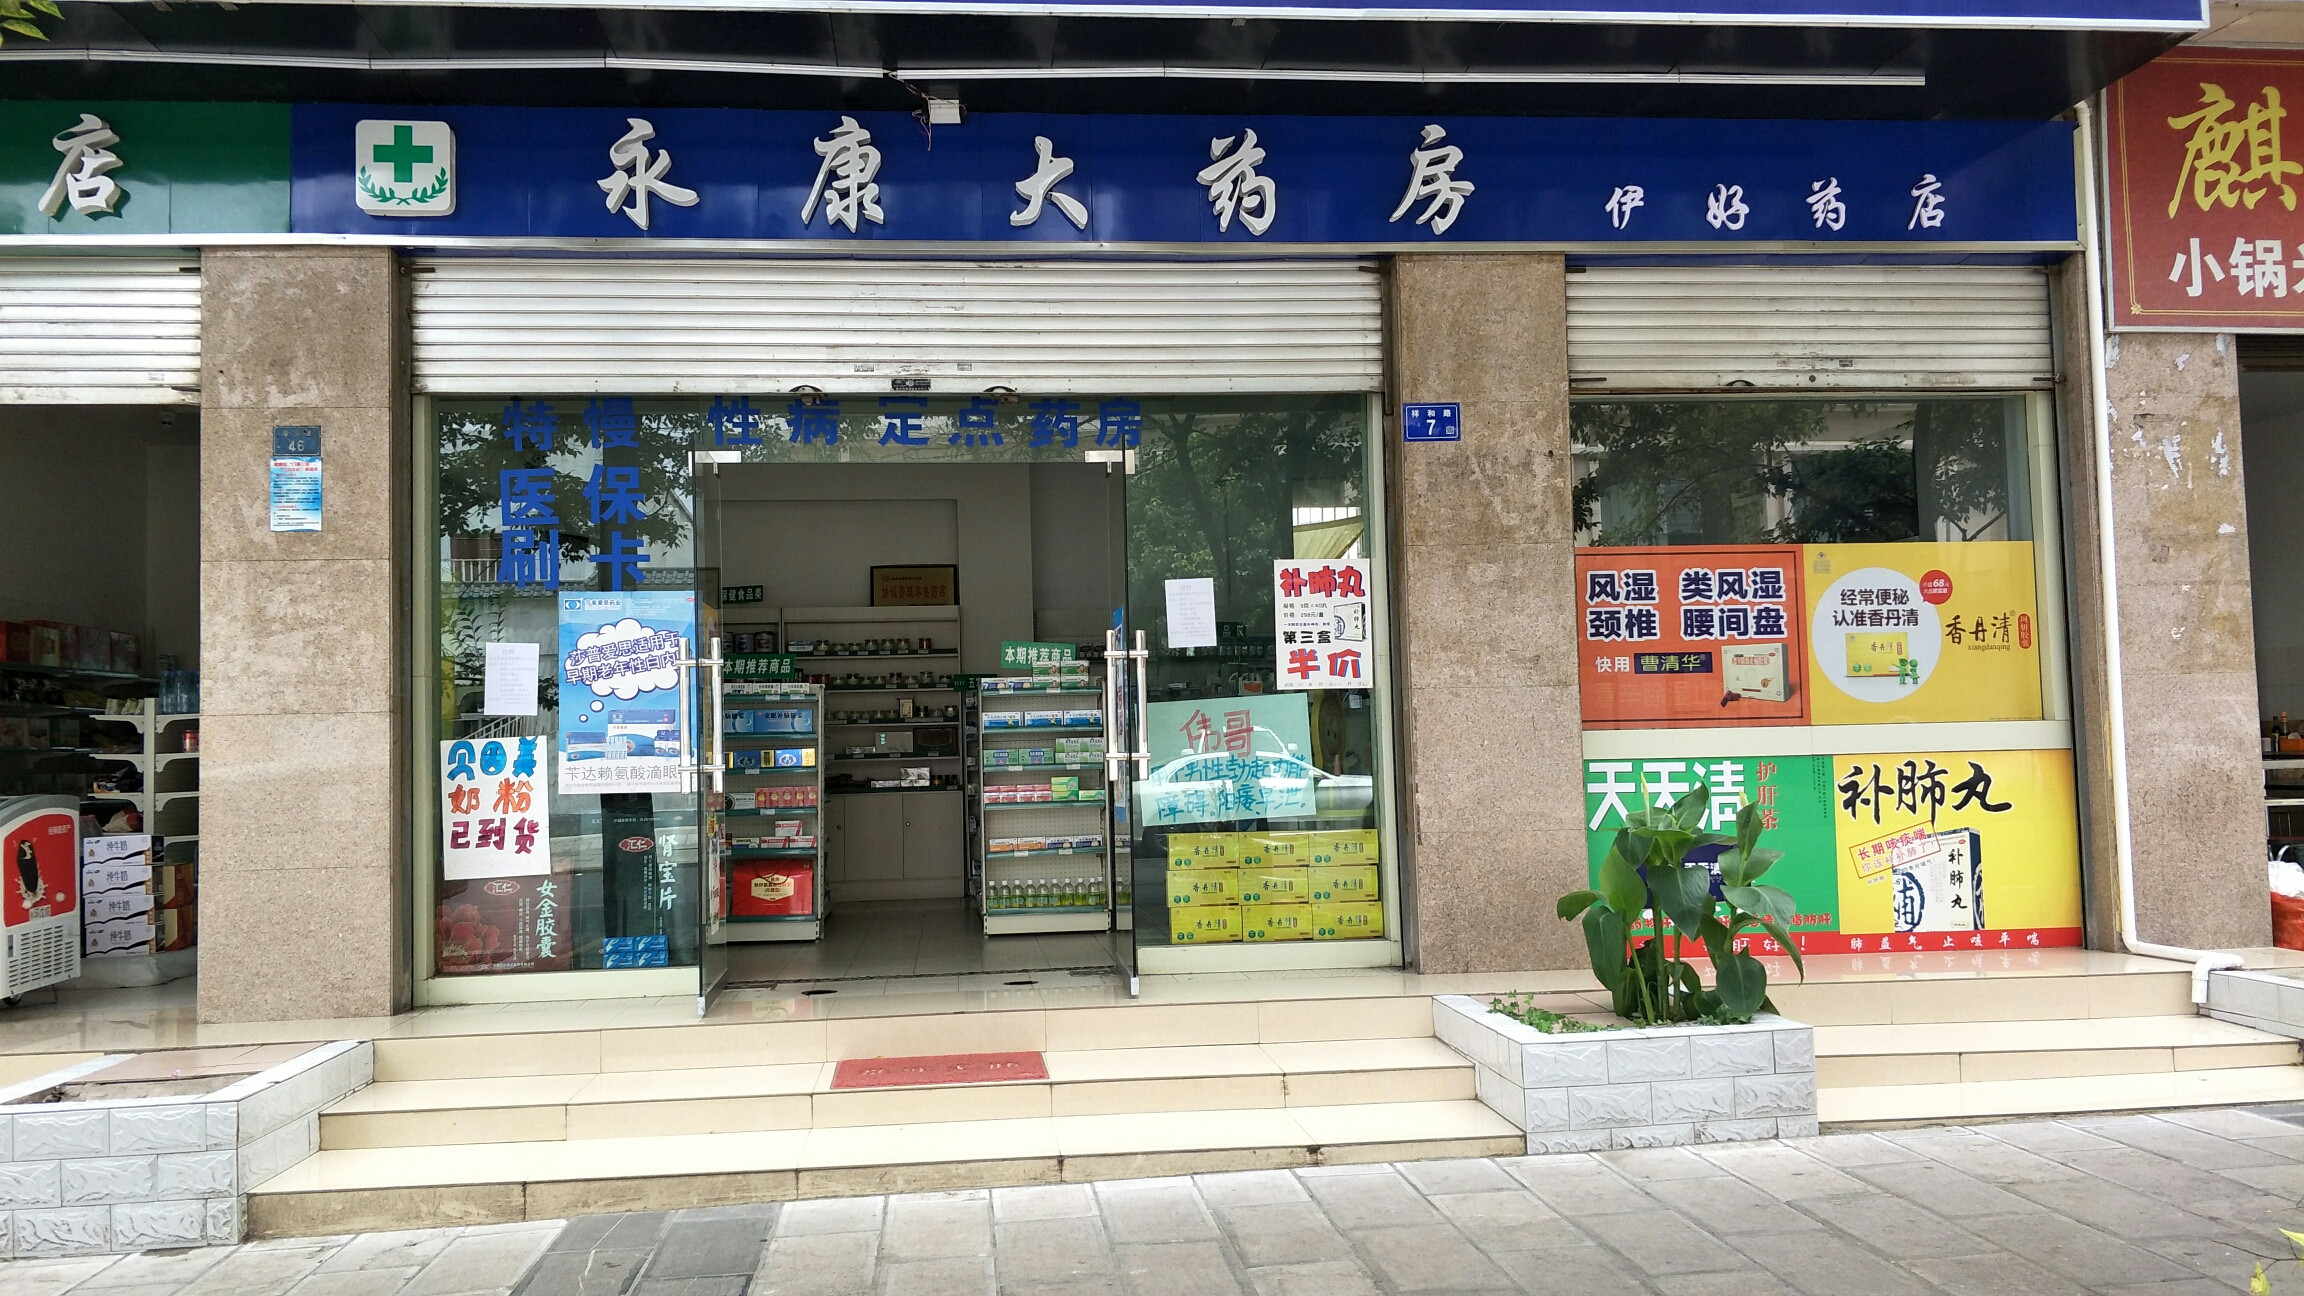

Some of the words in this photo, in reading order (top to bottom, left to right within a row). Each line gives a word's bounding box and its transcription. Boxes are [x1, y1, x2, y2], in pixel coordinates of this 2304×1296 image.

[38, 114, 125, 217] 店
[597, 115, 1475, 236] 永康大药房
[1606, 174, 1946, 232] 伊好药店
[1426, 419, 1436, 435] 7
[500, 463, 647, 526] 医保
[497, 528, 651, 592] 刷卡
[1279, 565, 1366, 598] 补肺丸
[1587, 570, 1658, 603] 风湿
[1680, 569, 1786, 602] 类风湿
[1840, 588, 1910, 607] 经常便秘
[1588, 607, 1660, 640] 颈椎
[1681, 605, 1786, 639] 腰间盘
[1833, 609, 1919, 627] 认准香丹清
[1945, 611, 2012, 645] 香丹清
[567, 631, 680, 667] 莎普爱思适用于
[1283, 630, 1332, 644] 第三盒
[1967, 643, 2011, 653] xiangdanqing
[565, 649, 680, 686] 早期老年性白内
[722, 658, 791, 675] 本期推荐商品
[1287, 648, 1361, 679] 半价
[1595, 656, 1630, 673] 快用
[1179, 709, 1254, 757] 伟哥
[565, 764, 682, 782] 苄达赖氨酸滴眼
[448, 777, 534, 815] 奶粉
[1587, 760, 1745, 832] 天天清
[1755, 760, 1778, 831] 护肝茶
[1838, 759, 2013, 828] 补肺丸
[449, 817, 540, 855] 已到货
[627, 839, 648, 851] 汇仁
[1858, 827, 1928, 861] 长期咳痰喘
[492, 881, 514, 894] 汇仁
[658, 834, 678, 911] 肾宝片
[1948, 848, 1968, 909] 补肺丸
[535, 879, 558, 958] 女金胶囊
